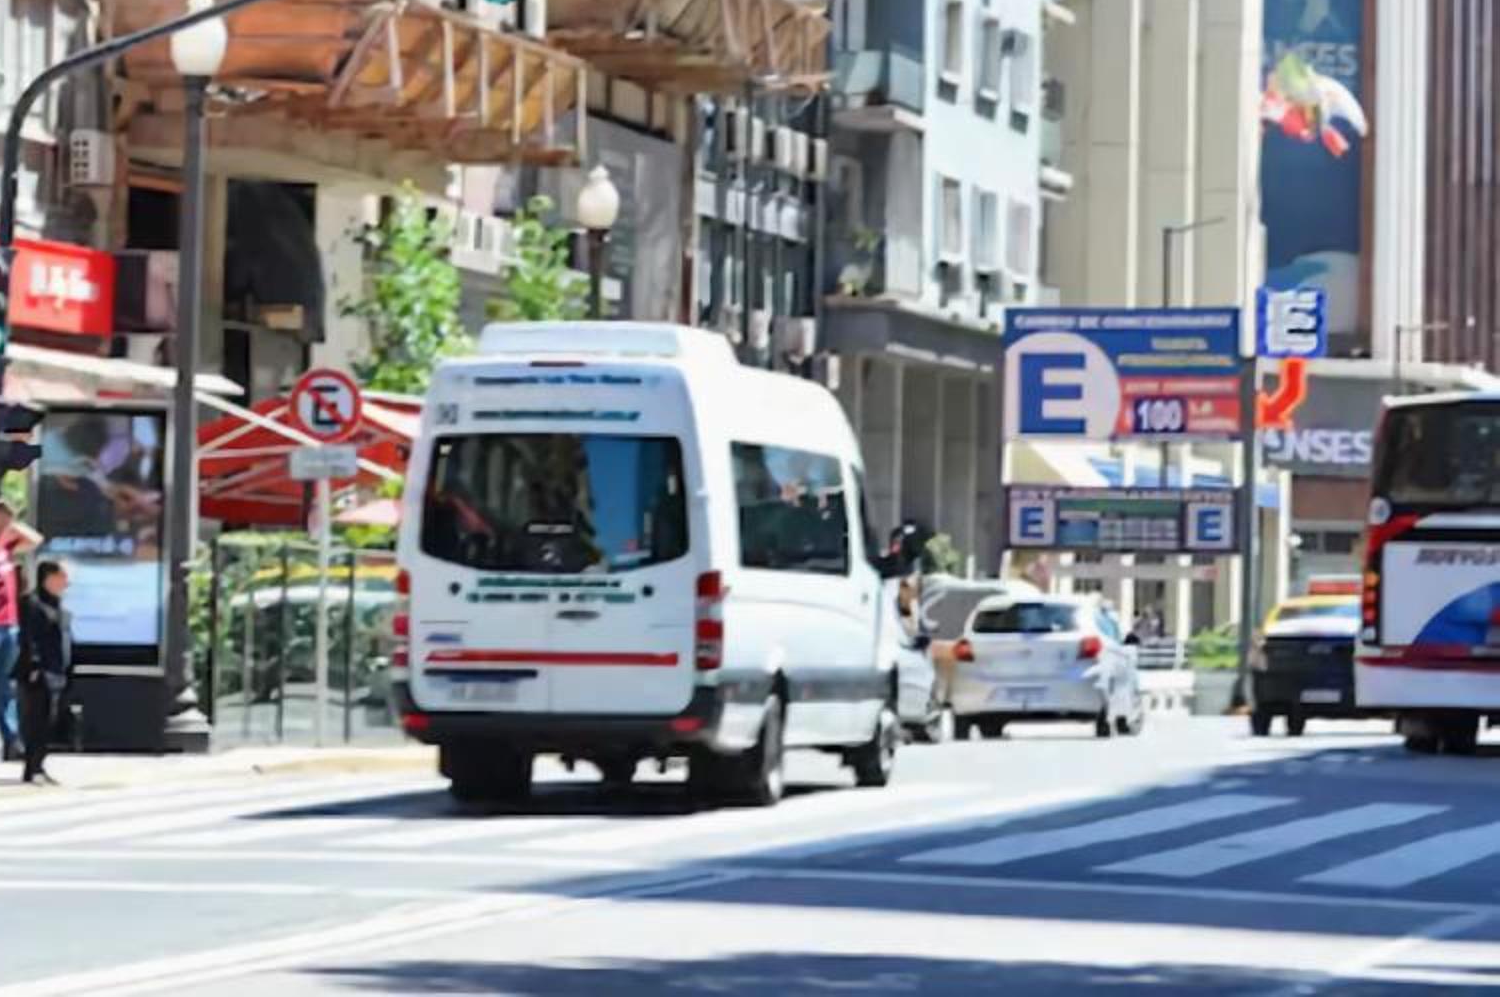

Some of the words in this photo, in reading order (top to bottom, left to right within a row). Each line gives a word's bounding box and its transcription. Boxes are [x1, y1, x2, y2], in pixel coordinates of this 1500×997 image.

[1266, 290, 1317, 353] E
[1020, 354, 1086, 434] E
[1019, 507, 1045, 538] E
[1197, 510, 1223, 542] E
